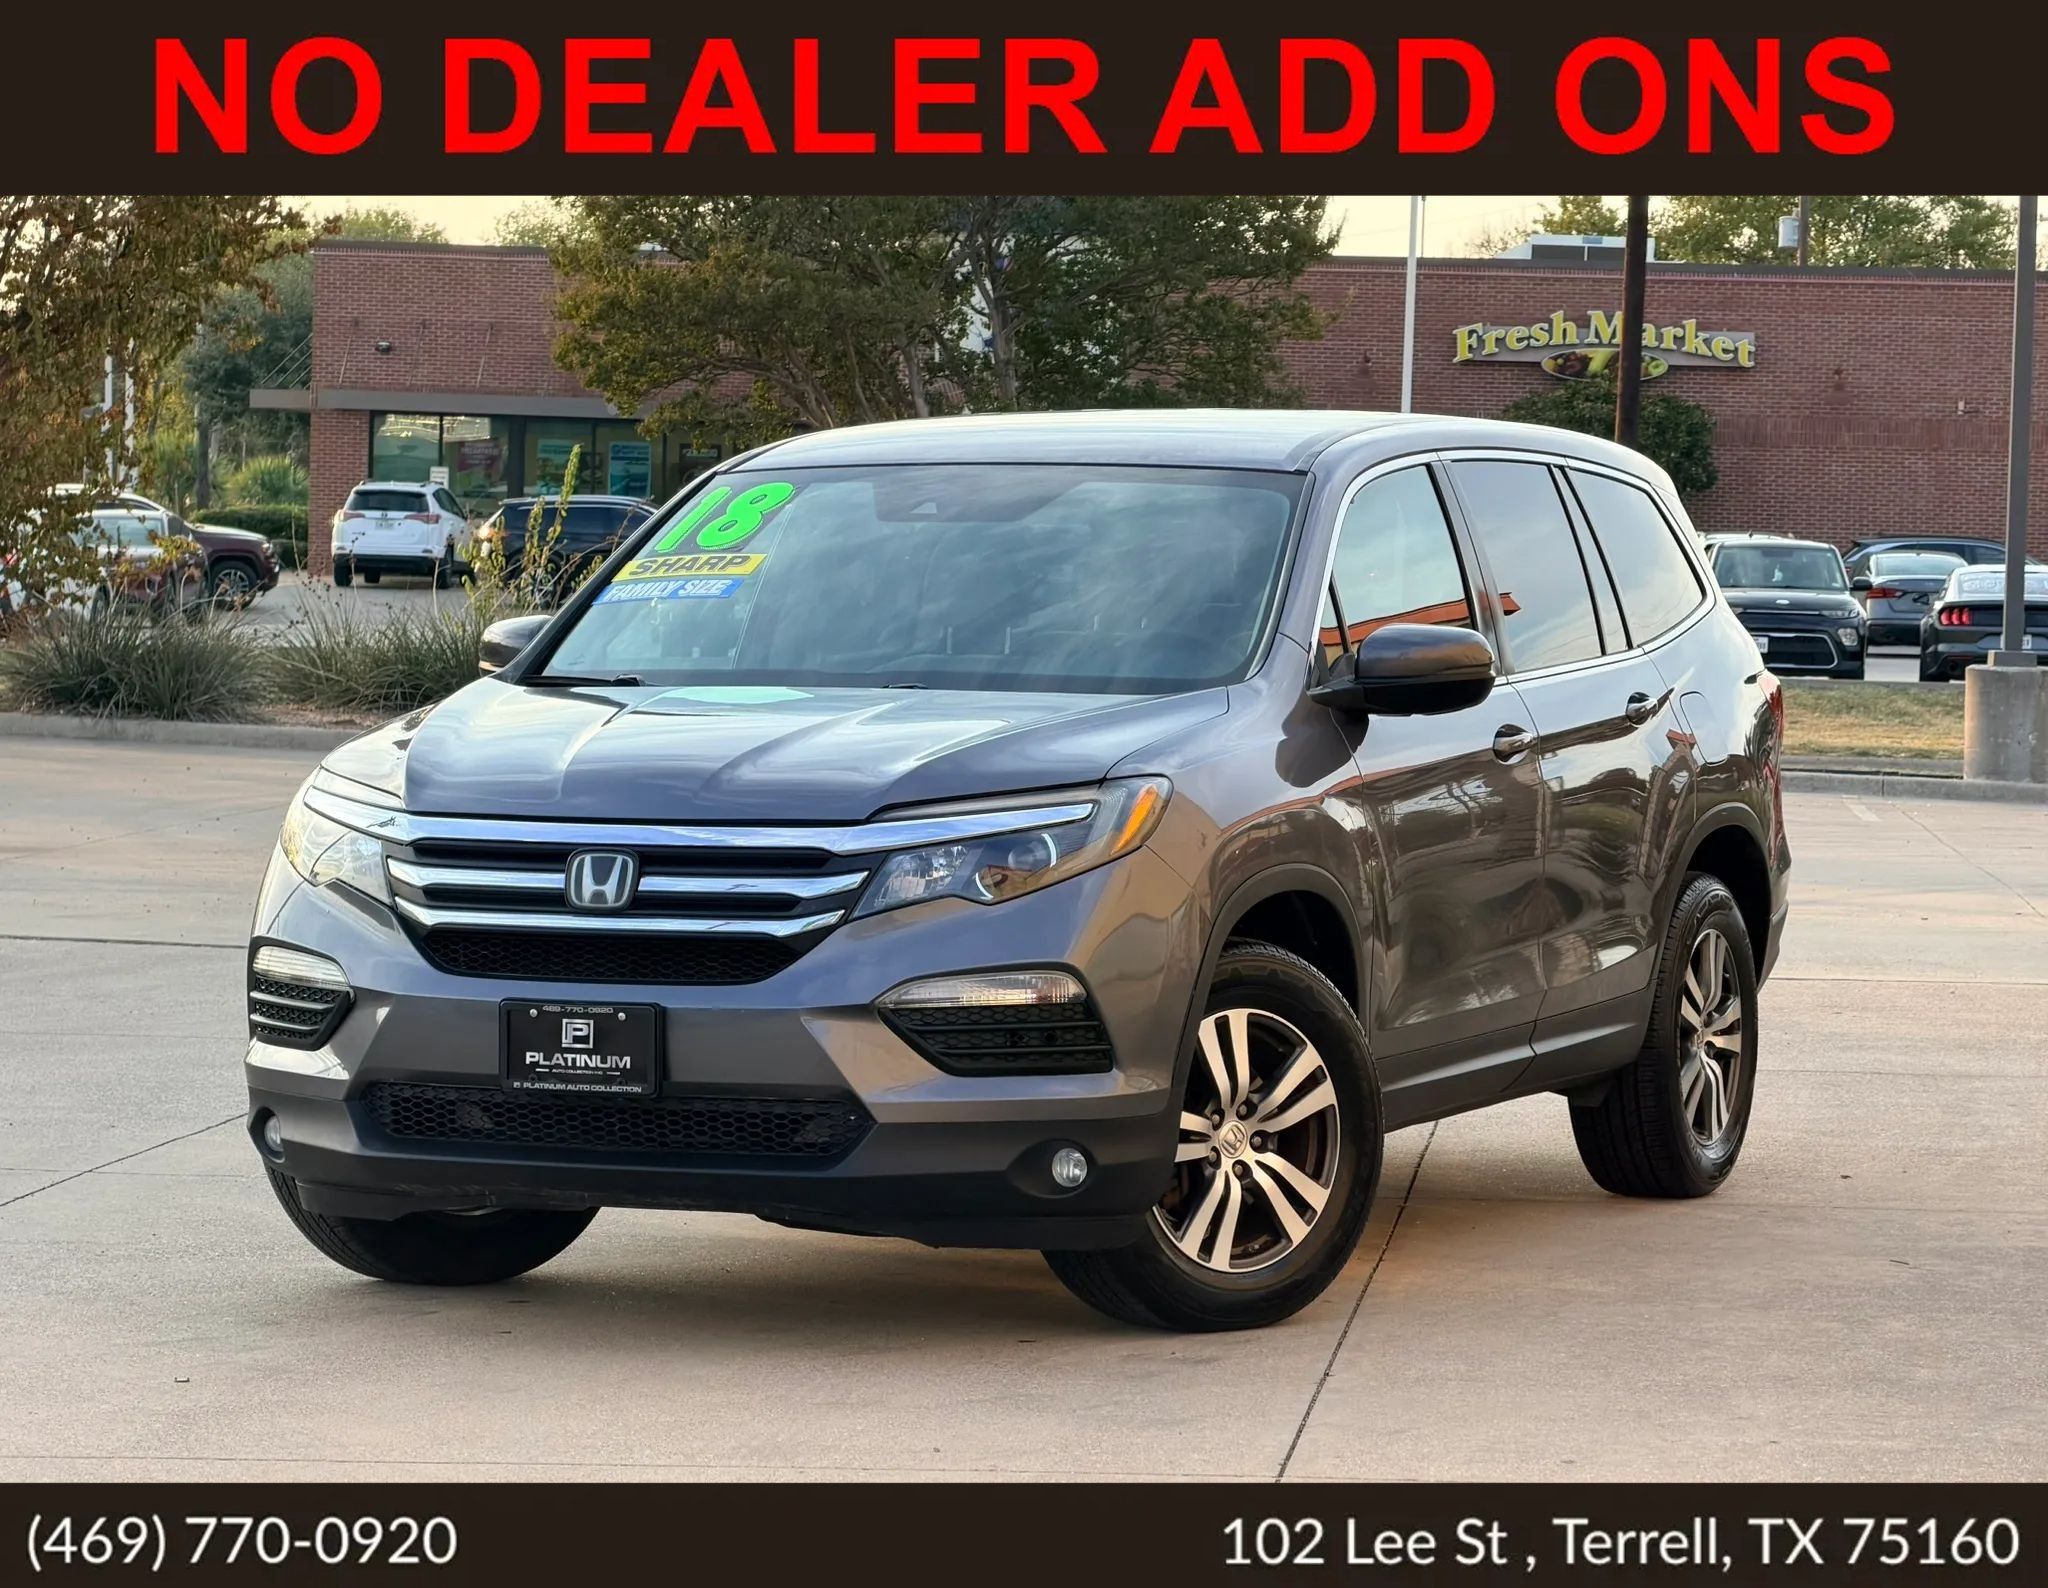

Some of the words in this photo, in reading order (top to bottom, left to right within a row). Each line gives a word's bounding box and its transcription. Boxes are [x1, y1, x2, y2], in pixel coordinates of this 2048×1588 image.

[1451, 309, 1580, 364] Fresh
[1584, 309, 1757, 369] Market
[654, 481, 796, 552] 18
[629, 555, 752, 576] SHARP
[605, 579, 681, 602] FAMILY
[678, 578, 734, 597] SIZE
[525, 1052, 631, 1069] PLATINUM
[523, 1082, 566, 1091] PLATINUM
